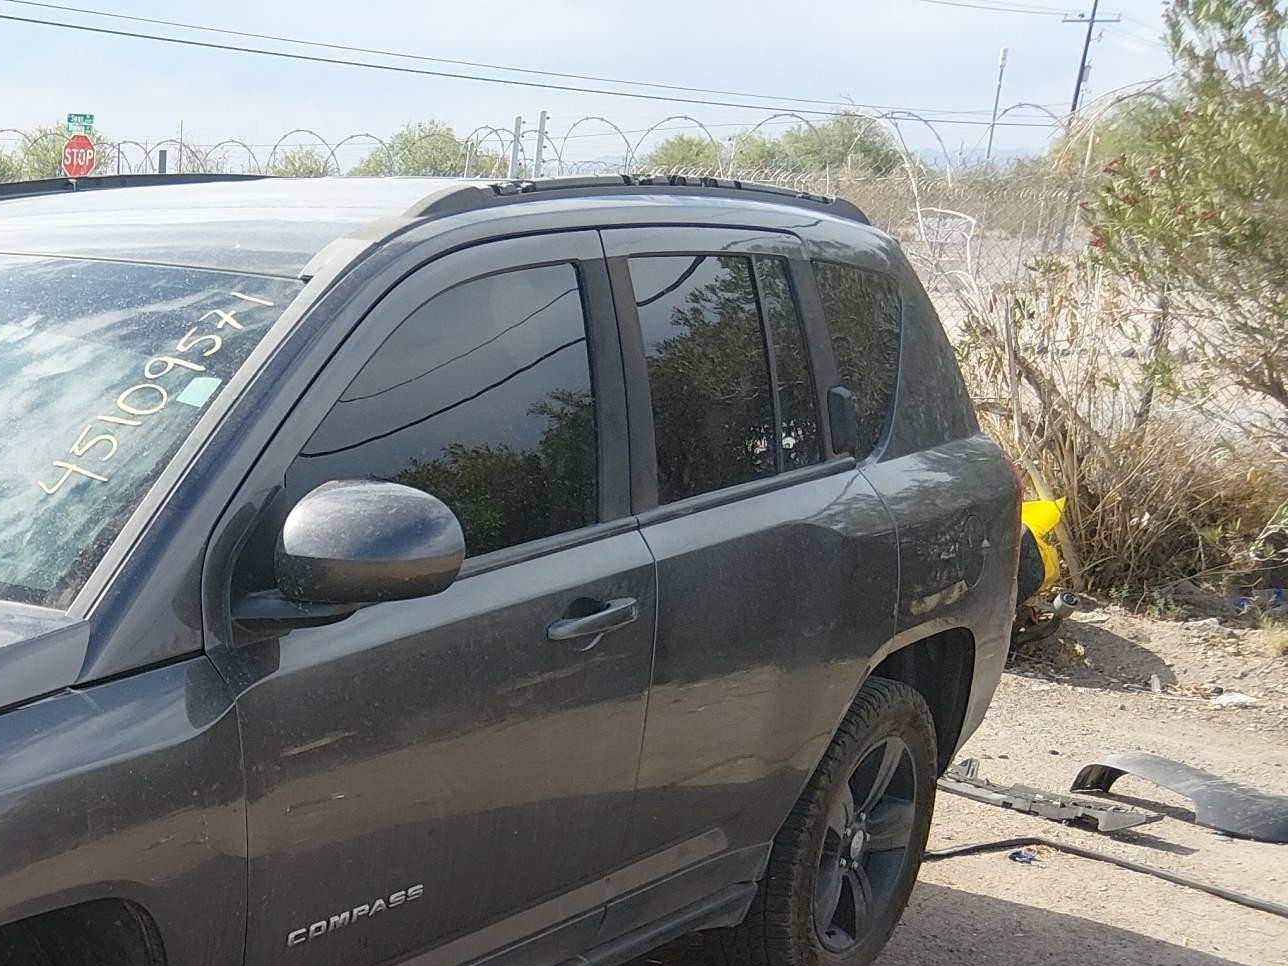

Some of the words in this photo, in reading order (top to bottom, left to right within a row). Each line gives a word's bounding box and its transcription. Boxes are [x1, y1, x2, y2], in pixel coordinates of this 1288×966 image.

[64, 149, 93, 166] STOP
[37, 291, 274, 495] 45109571
[287, 883, 424, 948] COMPASS
